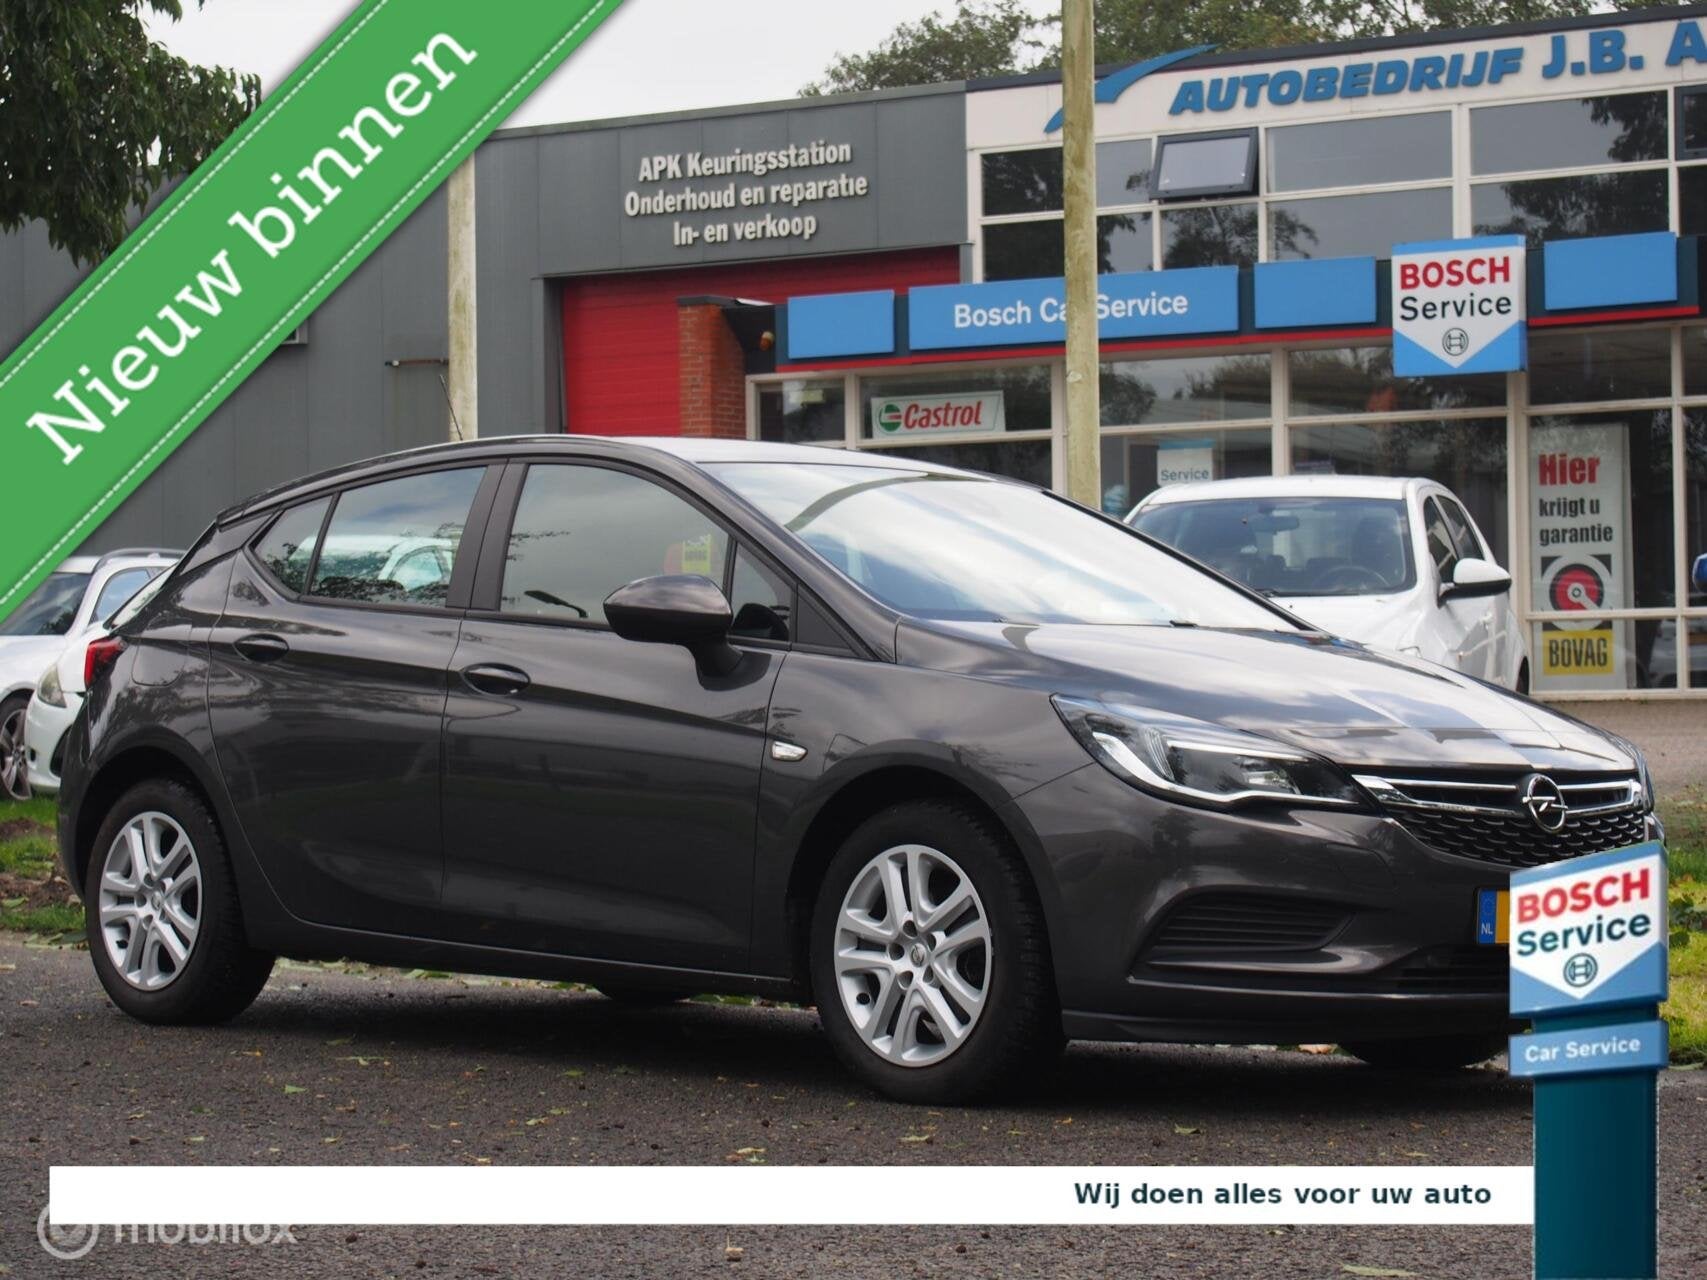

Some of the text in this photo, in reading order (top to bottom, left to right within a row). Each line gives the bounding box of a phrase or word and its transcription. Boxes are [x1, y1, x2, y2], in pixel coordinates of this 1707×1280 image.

[1168, 47, 1524, 116] AUTOBEDRIJF
[1542, 29, 1645, 81] J.B.
[638, 140, 851, 183] APK Keuringsstation
[625, 174, 868, 216] Onderhoud en reparatie
[674, 213, 816, 246] In- en verkoop
[1400, 256, 1510, 290] BOSCH
[954, 301, 1032, 328] Bosch
[1096, 291, 1188, 320] Service
[1400, 292, 1512, 321] Service
[903, 401, 982, 430] Castrol
[1161, 468, 1209, 481] Service
[1538, 454, 1600, 486] Hier
[1539, 498, 1600, 518] krijgt u
[1539, 524, 1613, 547] garantie
[1549, 637, 1608, 668] BOVAG
[1481, 922, 1493, 935] NL
